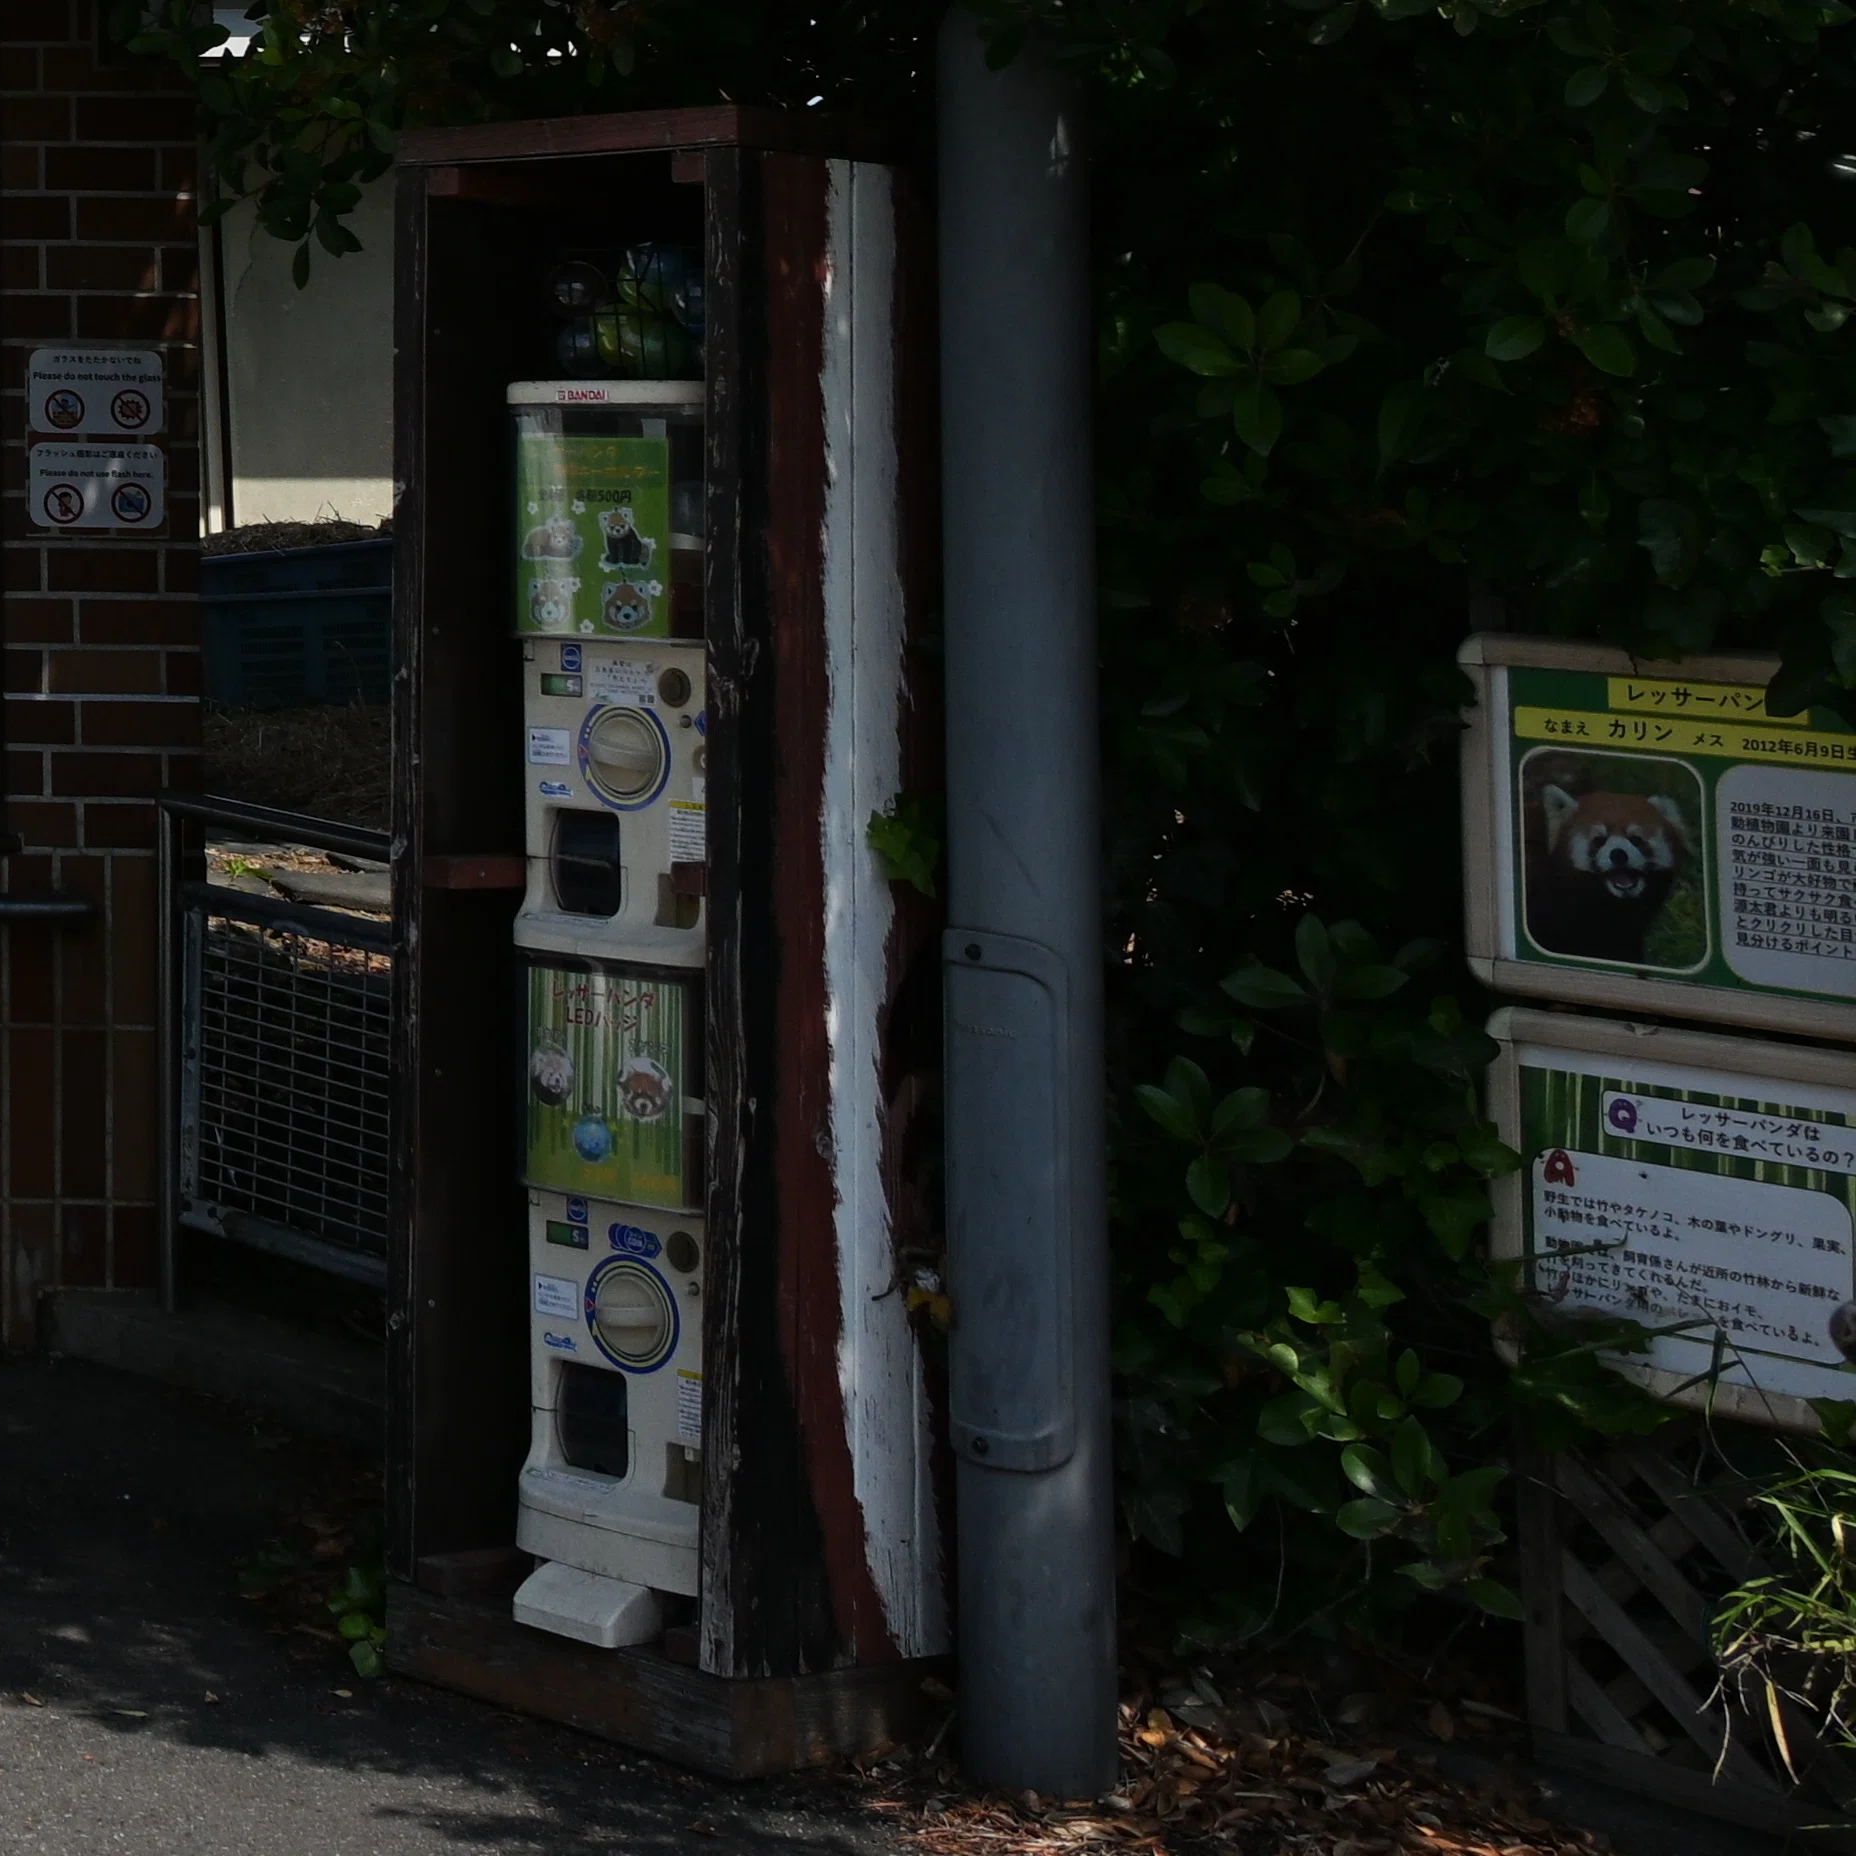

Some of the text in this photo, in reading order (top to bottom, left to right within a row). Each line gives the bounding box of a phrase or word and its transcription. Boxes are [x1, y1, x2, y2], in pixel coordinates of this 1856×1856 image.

[33, 371, 62, 381] Please
[63, 372, 76, 381] do
[77, 373, 93, 381] not
[94, 373, 120, 381] touch
[121, 373, 137, 381] the
[567, 389, 606, 401] BANDAI
[39, 468, 66, 477] Please
[67, 469, 79, 477] do
[111, 470, 131, 478] flash
[1626, 684, 1765, 711] レッサーパン
[1543, 718, 1590, 737] なまえ
[1608, 719, 1673, 742] カリン
[1692, 732, 1725, 748] メス
[1730, 801, 1856, 824] 2019年12月16日、
[1731, 815, 1856, 841] 動植物園より来園
[1731, 833, 1856, 858] のんびりした性格
[1731, 848, 1856, 875] 気が強い一面も見
[1734, 865, 1856, 892] リンゴが大好物で
[1734, 881, 1856, 908] 持ってサクサク食
[1734, 898, 1856, 924] 源太君よりも明る
[1736, 915, 1856, 942] とクリクリした目
[1681, 1107, 1821, 1142] レッサーパンダは
